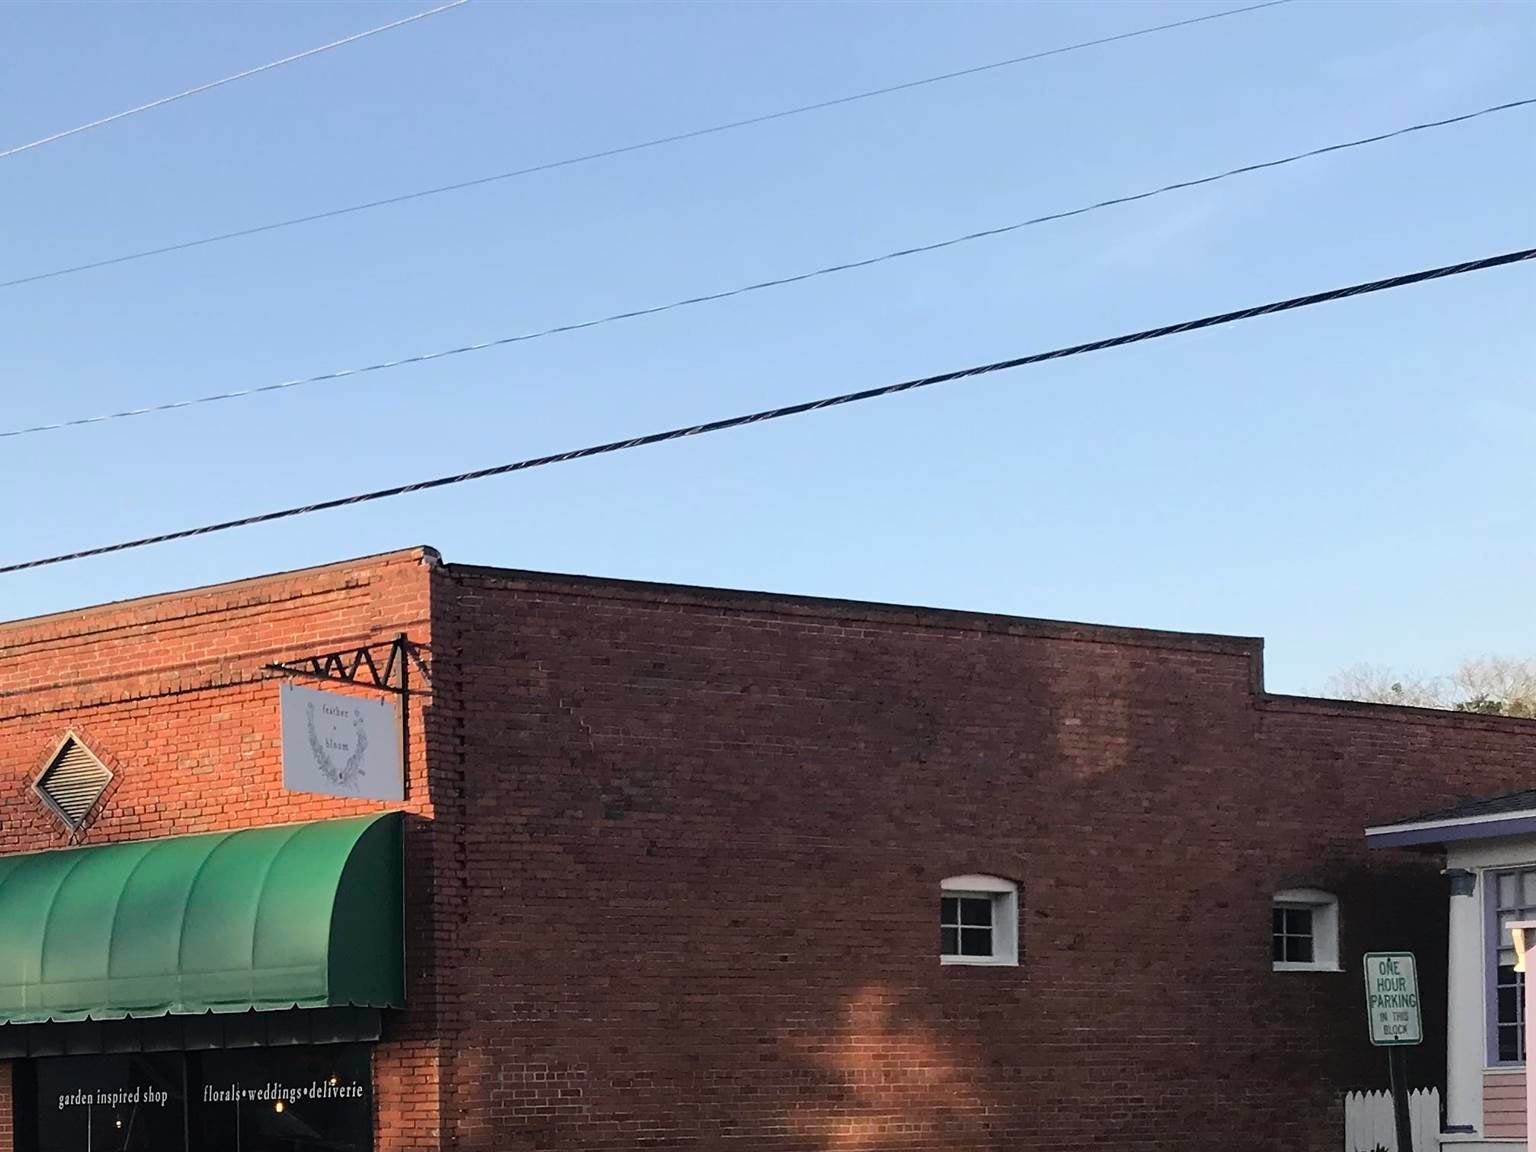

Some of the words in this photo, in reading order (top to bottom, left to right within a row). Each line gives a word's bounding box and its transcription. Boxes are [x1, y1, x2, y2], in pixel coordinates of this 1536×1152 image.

[325, 737, 349, 751] bloom
[1379, 961, 1400, 975] ONE
[1376, 977, 1406, 992] HOUR
[1370, 993, 1417, 1009] PARKING
[1379, 1011, 1388, 1022] IN
[1392, 1011, 1409, 1022] THIS
[1383, 1024, 1408, 1035] BLOCK
[58, 1089, 93, 1110] garden
[97, 1087, 140, 1108] inspired
[143, 1085, 168, 1107] shop
